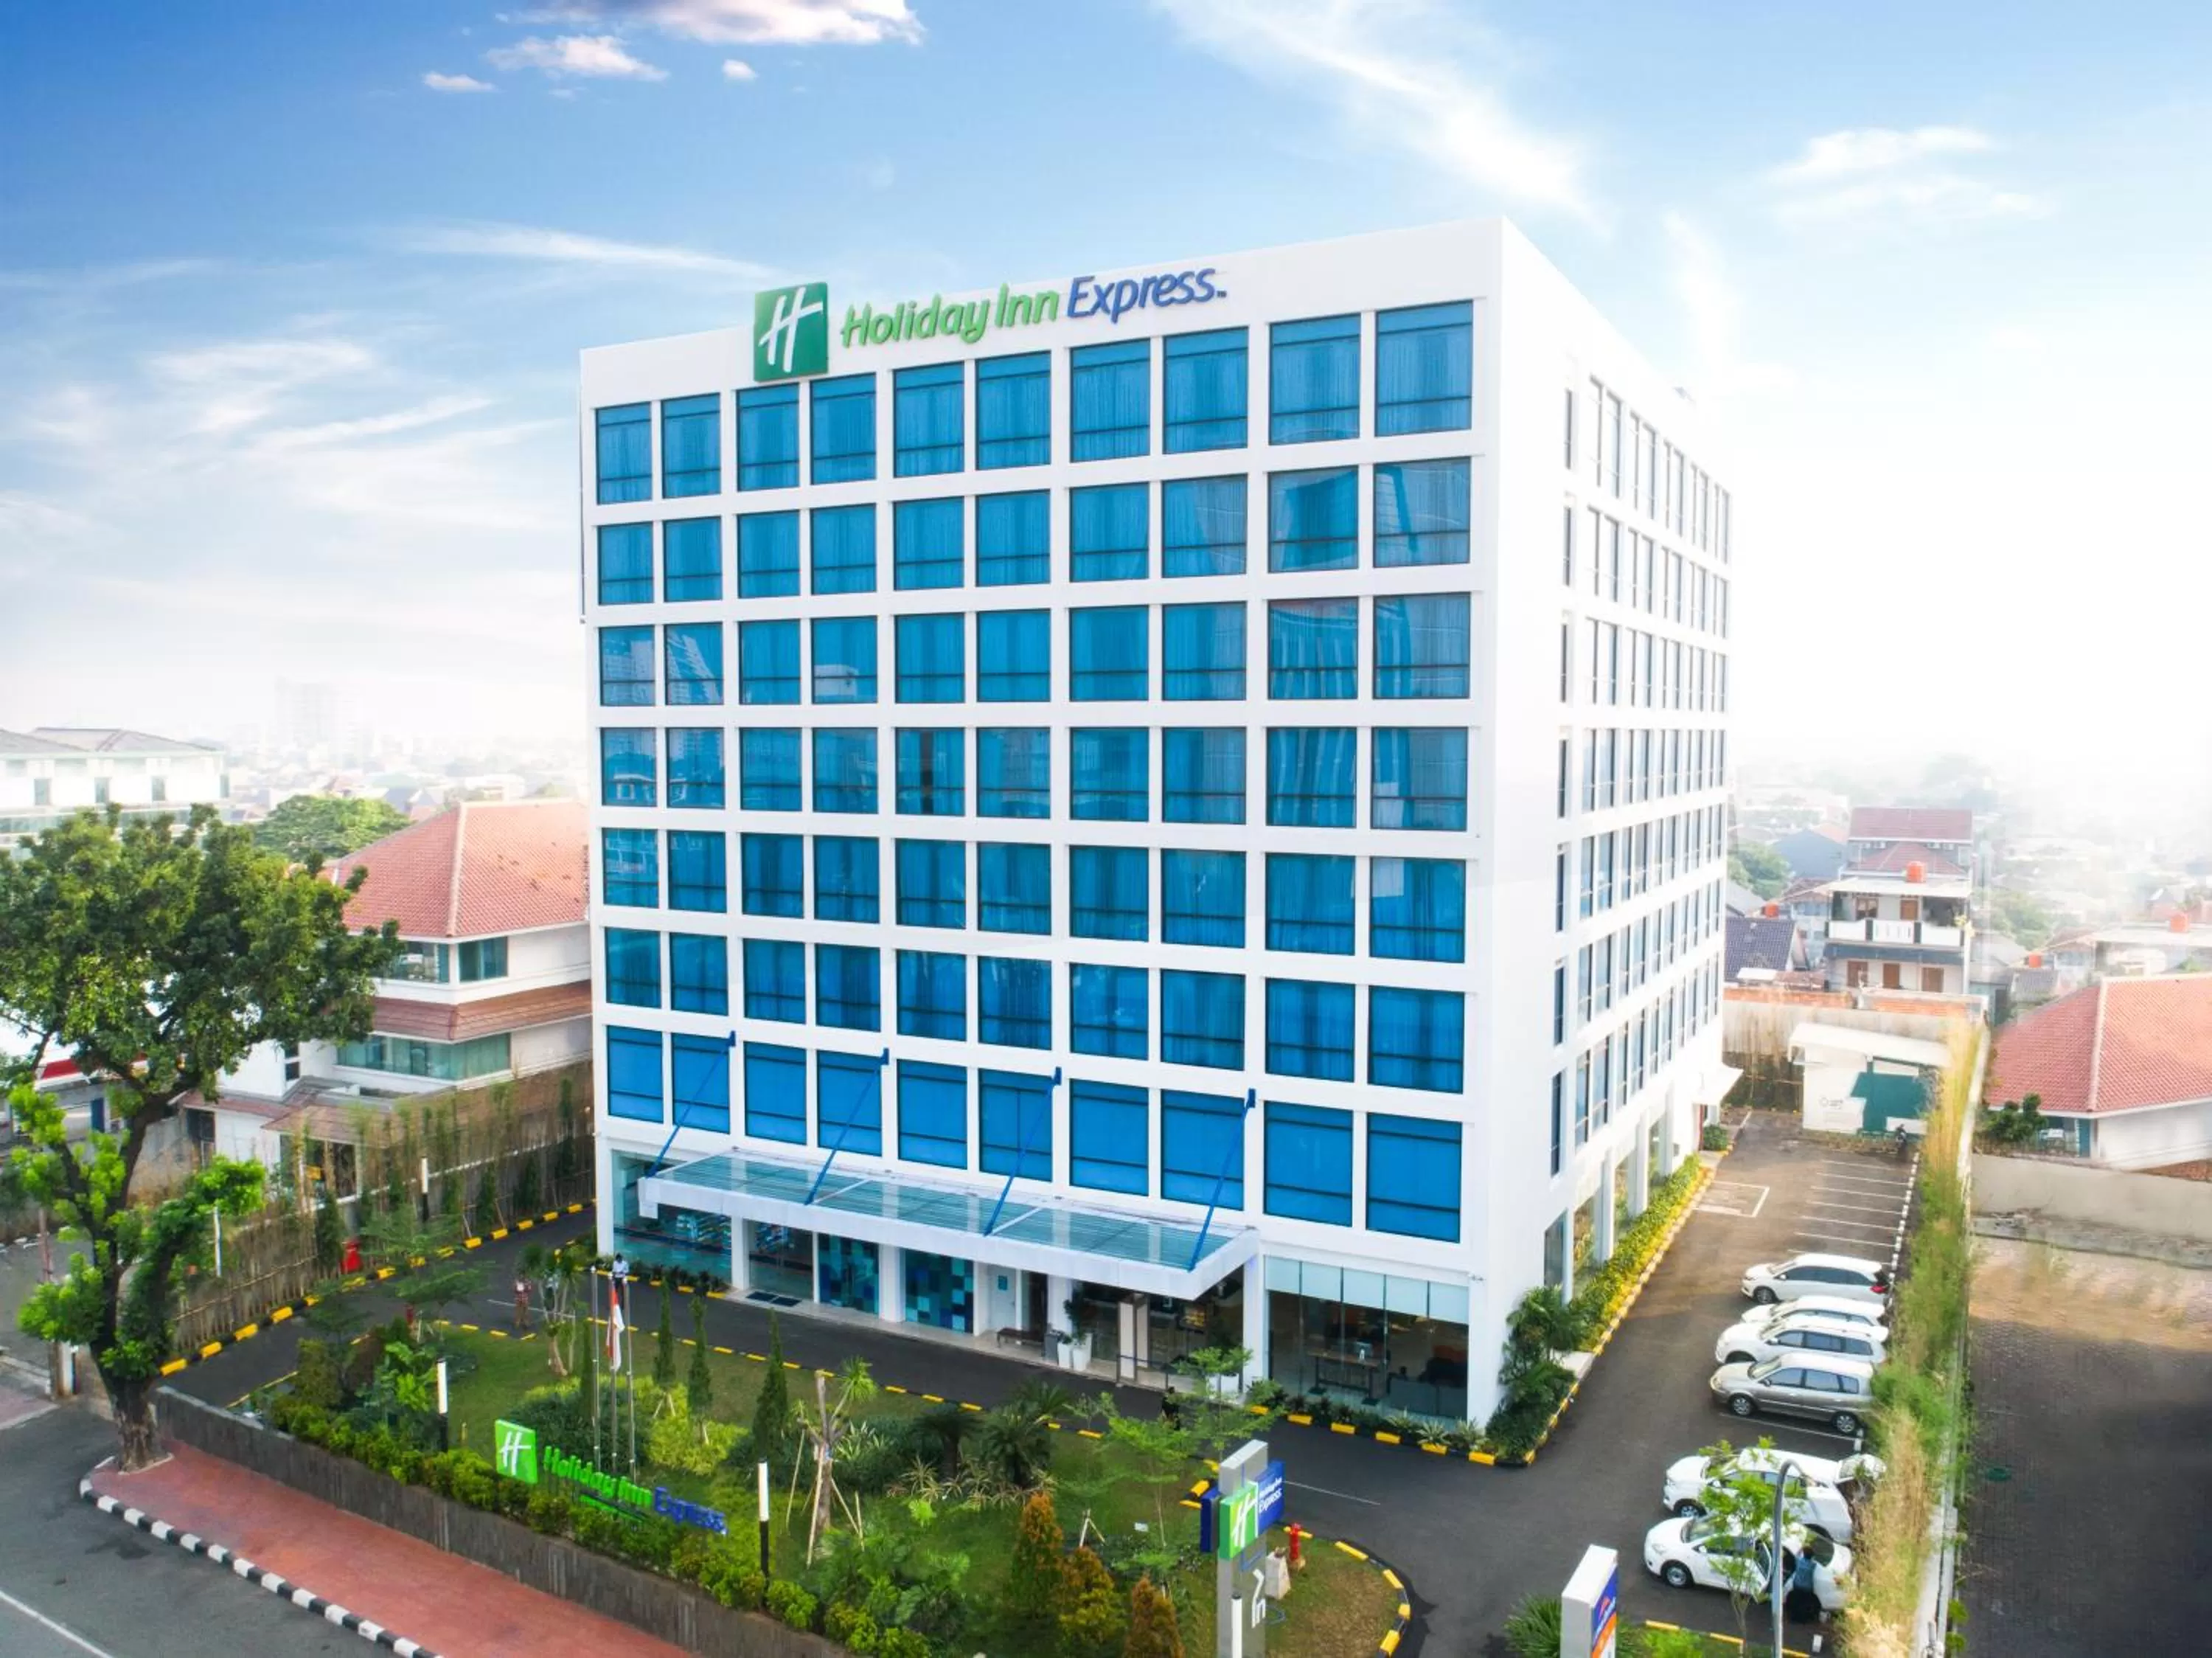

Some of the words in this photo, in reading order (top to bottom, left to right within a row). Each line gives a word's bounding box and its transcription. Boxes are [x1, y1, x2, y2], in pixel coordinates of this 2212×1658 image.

[841, 292, 991, 349] Holiday
[995, 282, 1060, 327] Inn
[1067, 267, 1216, 325] Express
